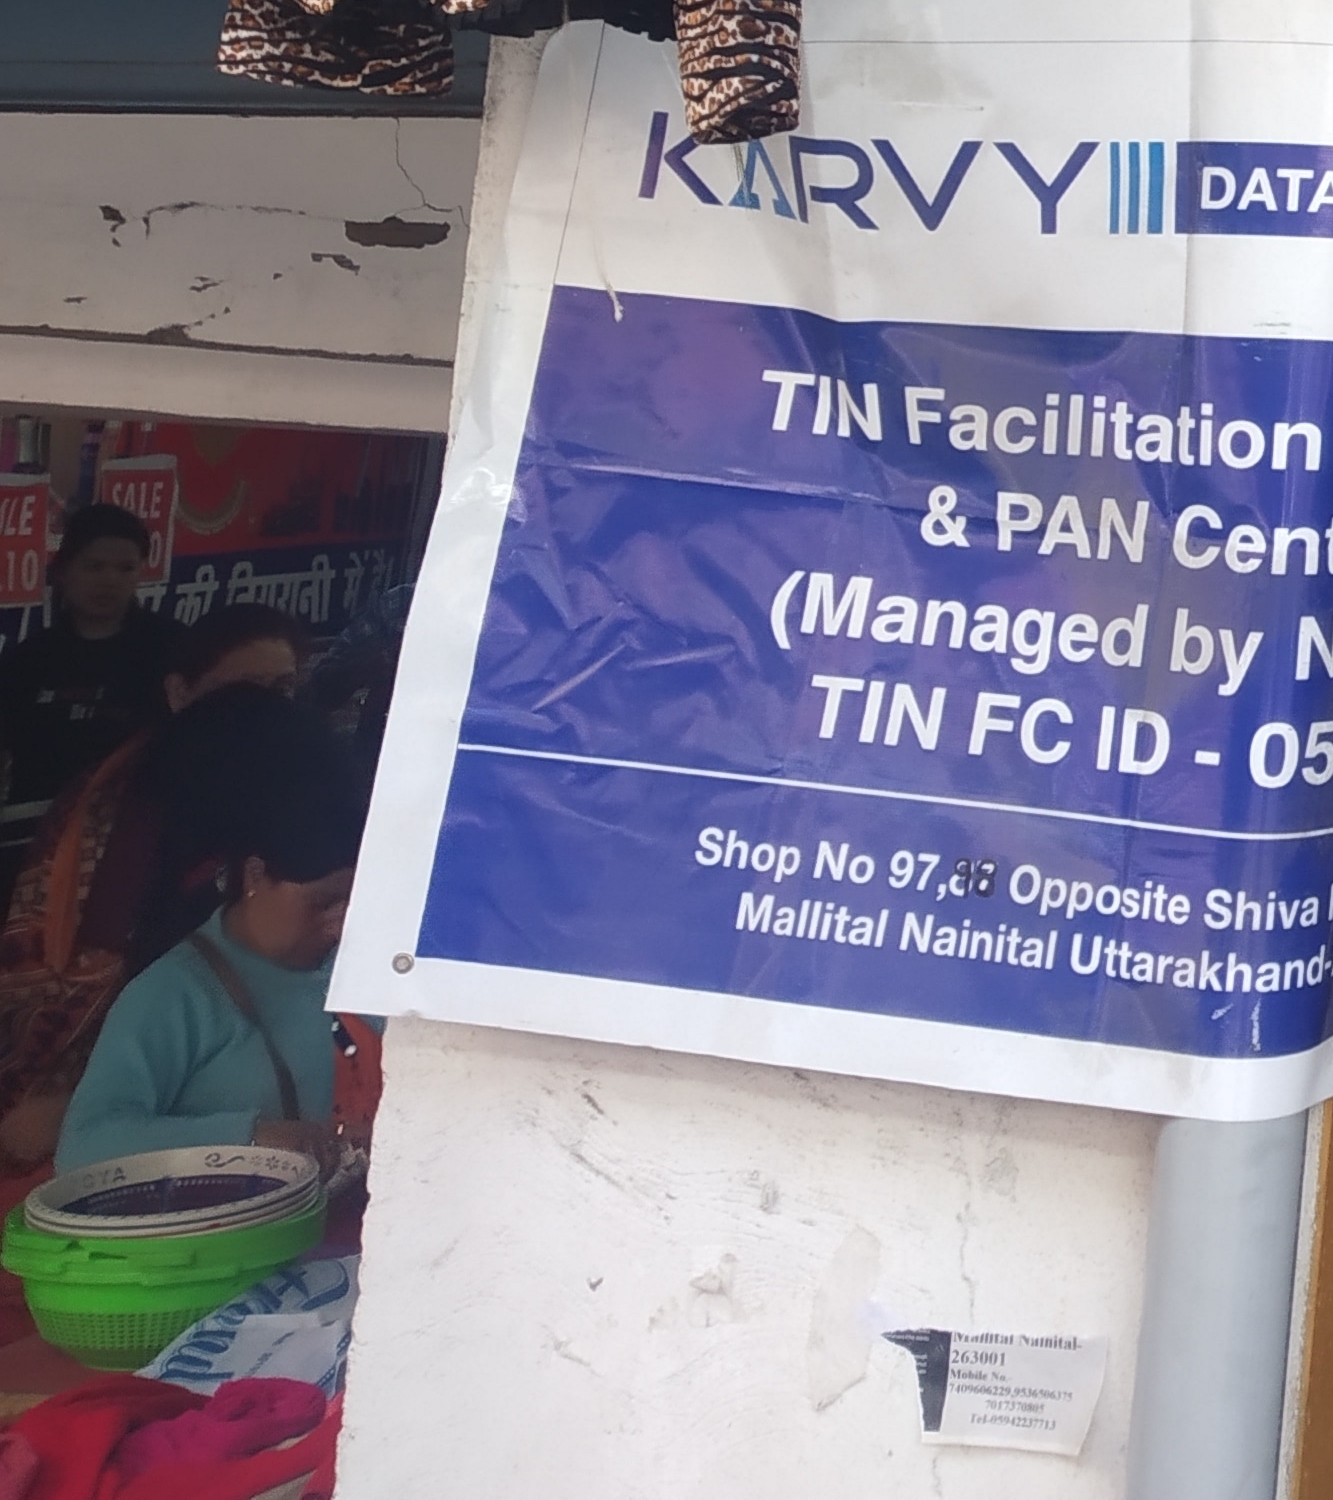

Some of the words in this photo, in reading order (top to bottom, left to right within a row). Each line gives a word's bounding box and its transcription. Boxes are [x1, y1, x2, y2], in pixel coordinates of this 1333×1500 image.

[638, 111, 1099, 235] KARVY
[762, 369, 882, 443] TIN
[905, 387, 1322, 471] Facilitation
[920, 488, 968, 547] &
[997, 493, 1149, 565] PAN
[770, 571, 1149, 673] (Managed
[1169, 608, 1264, 696] by
[811, 676, 945, 751] TIN
[967, 691, 1072, 764] FC
[1095, 705, 1170, 776] ID
[695, 826, 801, 883] Shop
[813, 840, 875, 884] No
[1009, 863, 1190, 925] Opposite
[1203, 888, 1319, 931] Shiva
[735, 891, 889, 948] Mallital
[899, 911, 1058, 970] Nainital
[950, 1368, 988, 1382] Mobile
[951, 1349, 1006, 1367] 263001
